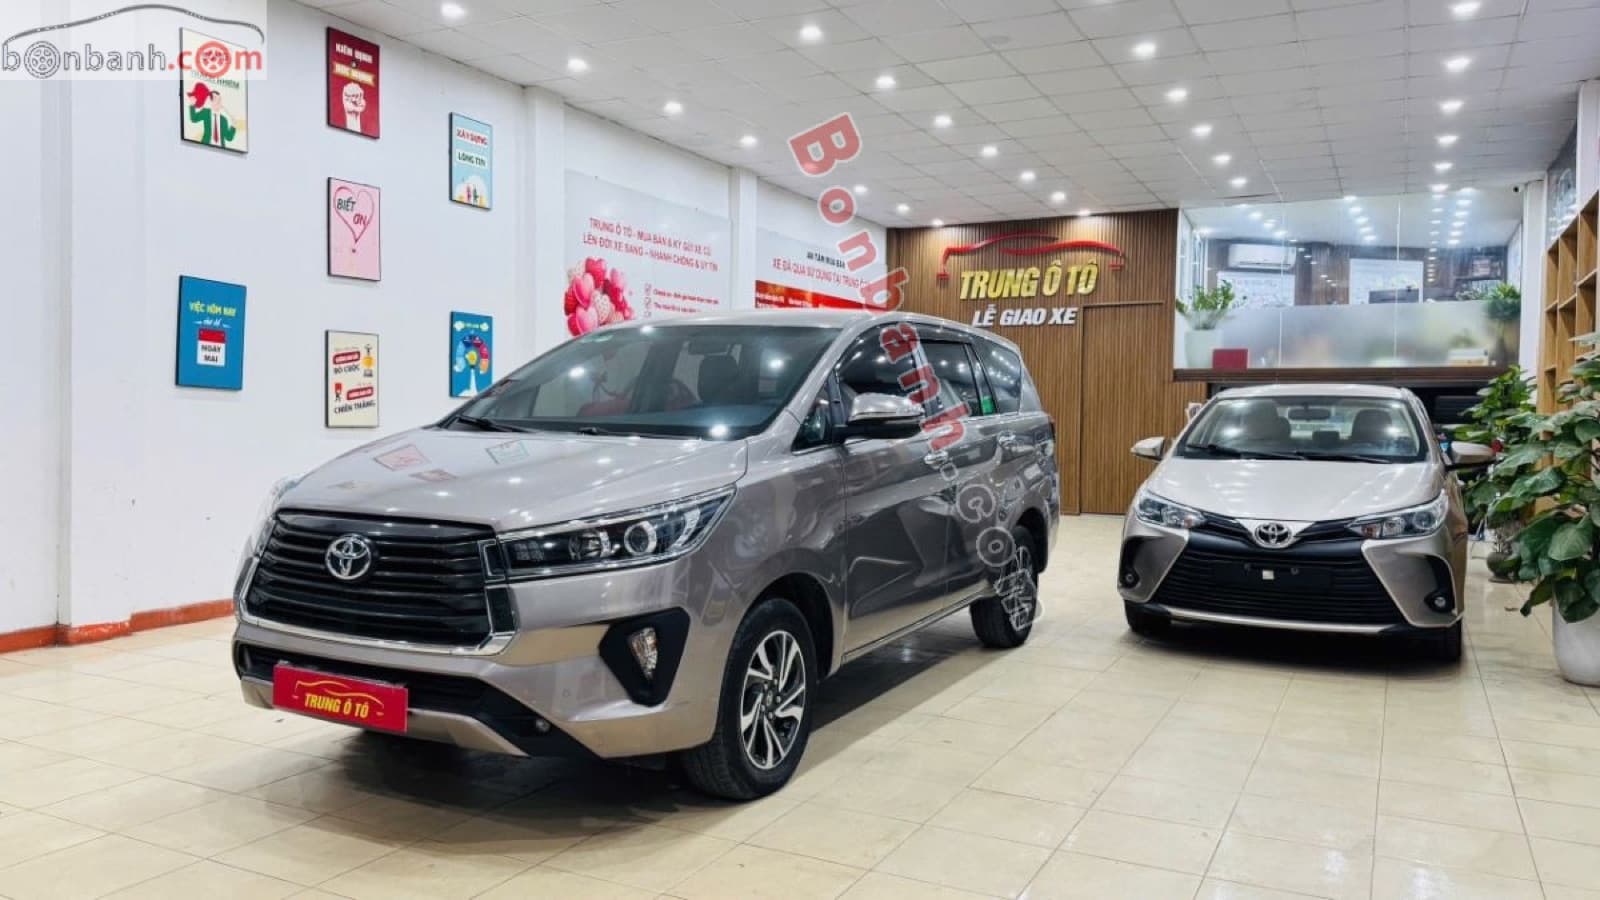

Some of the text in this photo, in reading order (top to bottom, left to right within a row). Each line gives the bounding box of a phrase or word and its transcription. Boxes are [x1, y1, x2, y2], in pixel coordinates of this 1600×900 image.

[590, 217, 614, 233] TRUNG
[637, 230, 652, 242] MUA
[959, 259, 1098, 300] TRUNG Ô TÔ
[972, 303, 1078, 328] LỄ GIAO XE
[304, 692, 369, 718] TRUNG Ô TÔ
